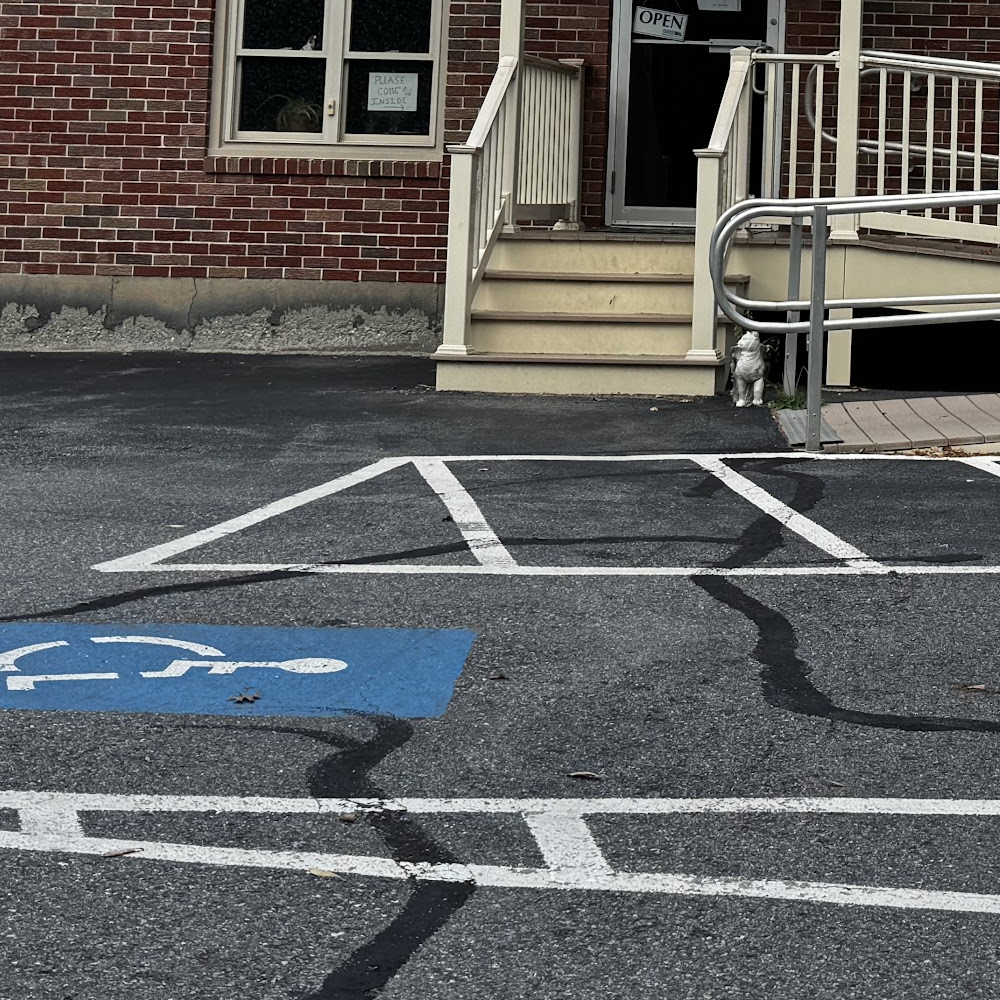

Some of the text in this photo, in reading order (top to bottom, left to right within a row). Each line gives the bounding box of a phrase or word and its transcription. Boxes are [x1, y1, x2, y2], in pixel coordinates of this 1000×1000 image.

[639, 10, 684, 29] OPEN
[375, 76, 405, 84] PLEASE
[377, 87, 401, 95] COME
[371, 97, 407, 105] INSIDE
